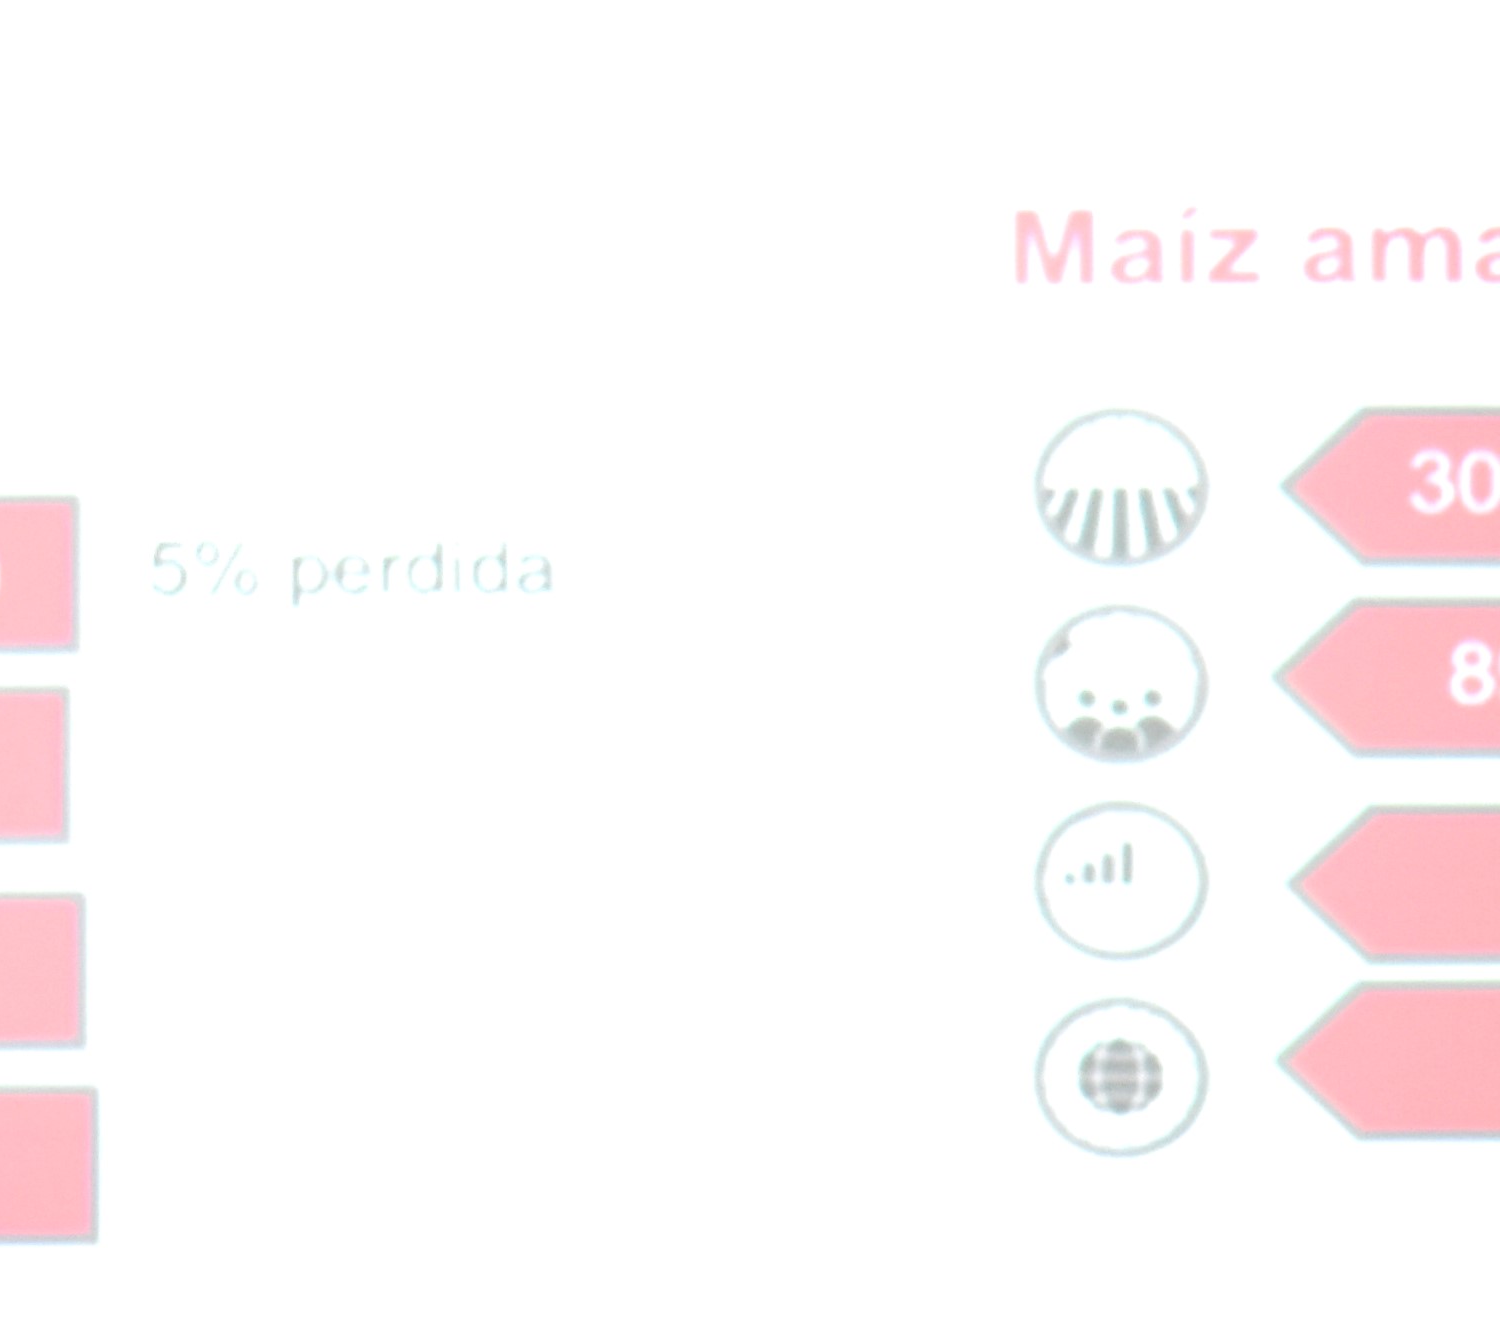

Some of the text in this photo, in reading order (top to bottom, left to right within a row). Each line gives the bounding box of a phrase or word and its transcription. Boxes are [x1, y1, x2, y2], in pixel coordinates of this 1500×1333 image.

[1015, 207, 1260, 285] Maíz
[152, 541, 553, 608] 5% perdida
[1448, 639, 1500, 707] 8
